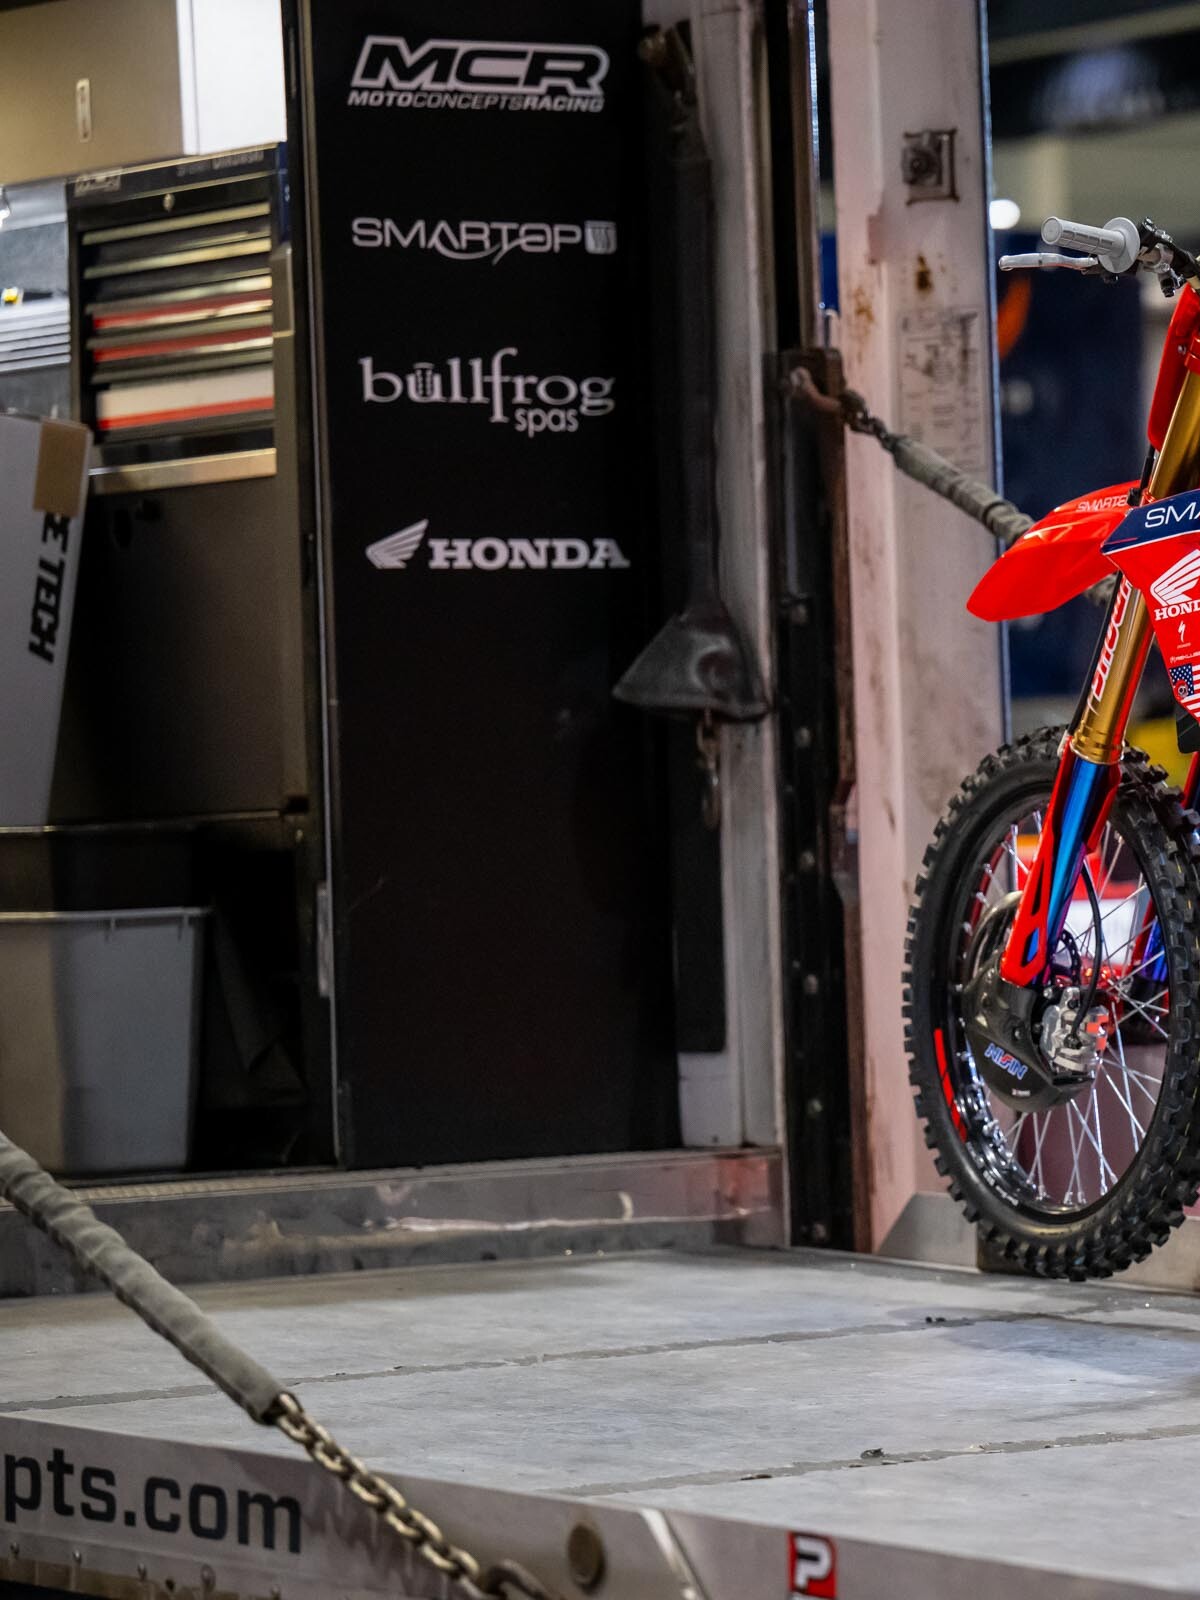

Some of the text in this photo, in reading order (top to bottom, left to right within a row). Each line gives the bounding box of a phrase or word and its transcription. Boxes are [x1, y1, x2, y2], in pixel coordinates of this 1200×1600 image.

[351, 35, 610, 93] MCR
[348, 89, 605, 113] MOTOCONCEPTSRACING
[352, 217, 583, 265] SMARTOP
[358, 347, 616, 424] bullfrog
[514, 407, 579, 438] spas
[1076, 494, 1129, 514] SMARTO
[428, 537, 632, 571] HONDA
[3, 1447, 301, 1553] pts.com
